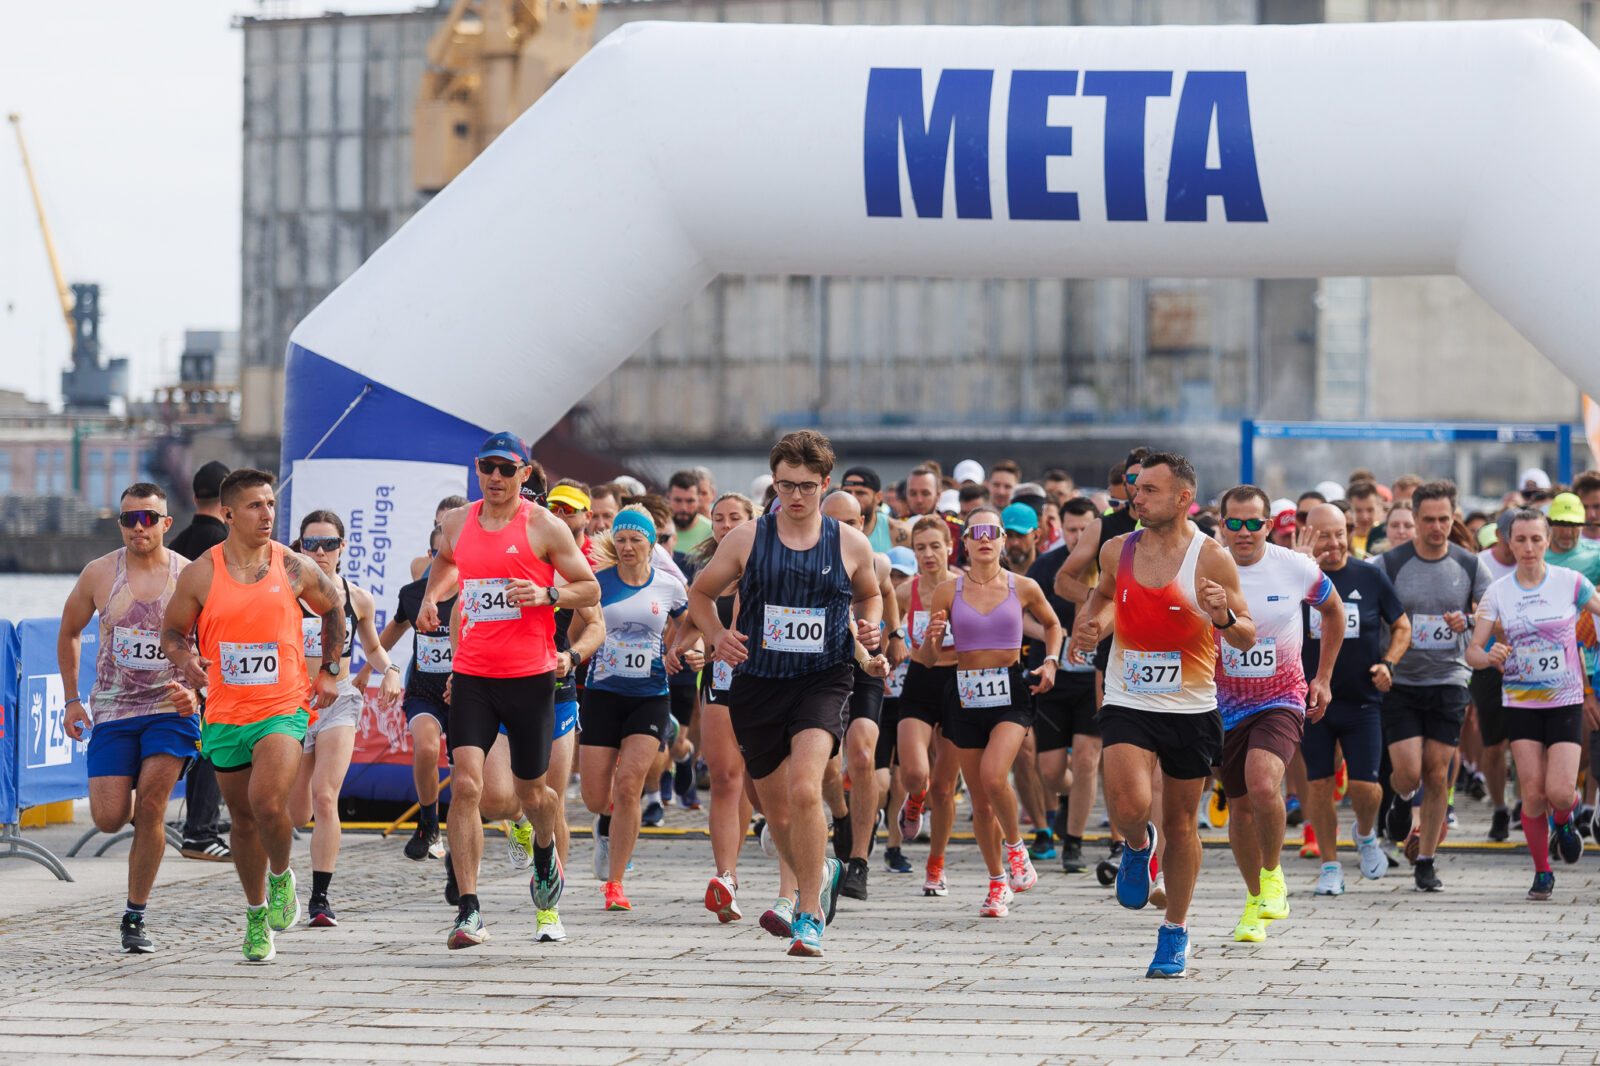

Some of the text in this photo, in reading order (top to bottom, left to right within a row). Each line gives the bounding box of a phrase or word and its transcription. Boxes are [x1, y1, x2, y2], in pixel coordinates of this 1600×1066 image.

[864, 68, 1268, 222] META
[363, 485, 395, 577] Żeglugą
[784, 622, 823, 641] 100
[1433, 626, 1453, 640] 63
[132, 642, 166, 660] 138
[1239, 650, 1274, 667] 105
[239, 655, 277, 674] 170
[624, 653, 646, 669] 10
[1538, 656, 1560, 672] 93
[1141, 665, 1180, 683] 377
[975, 680, 1009, 698] 111
